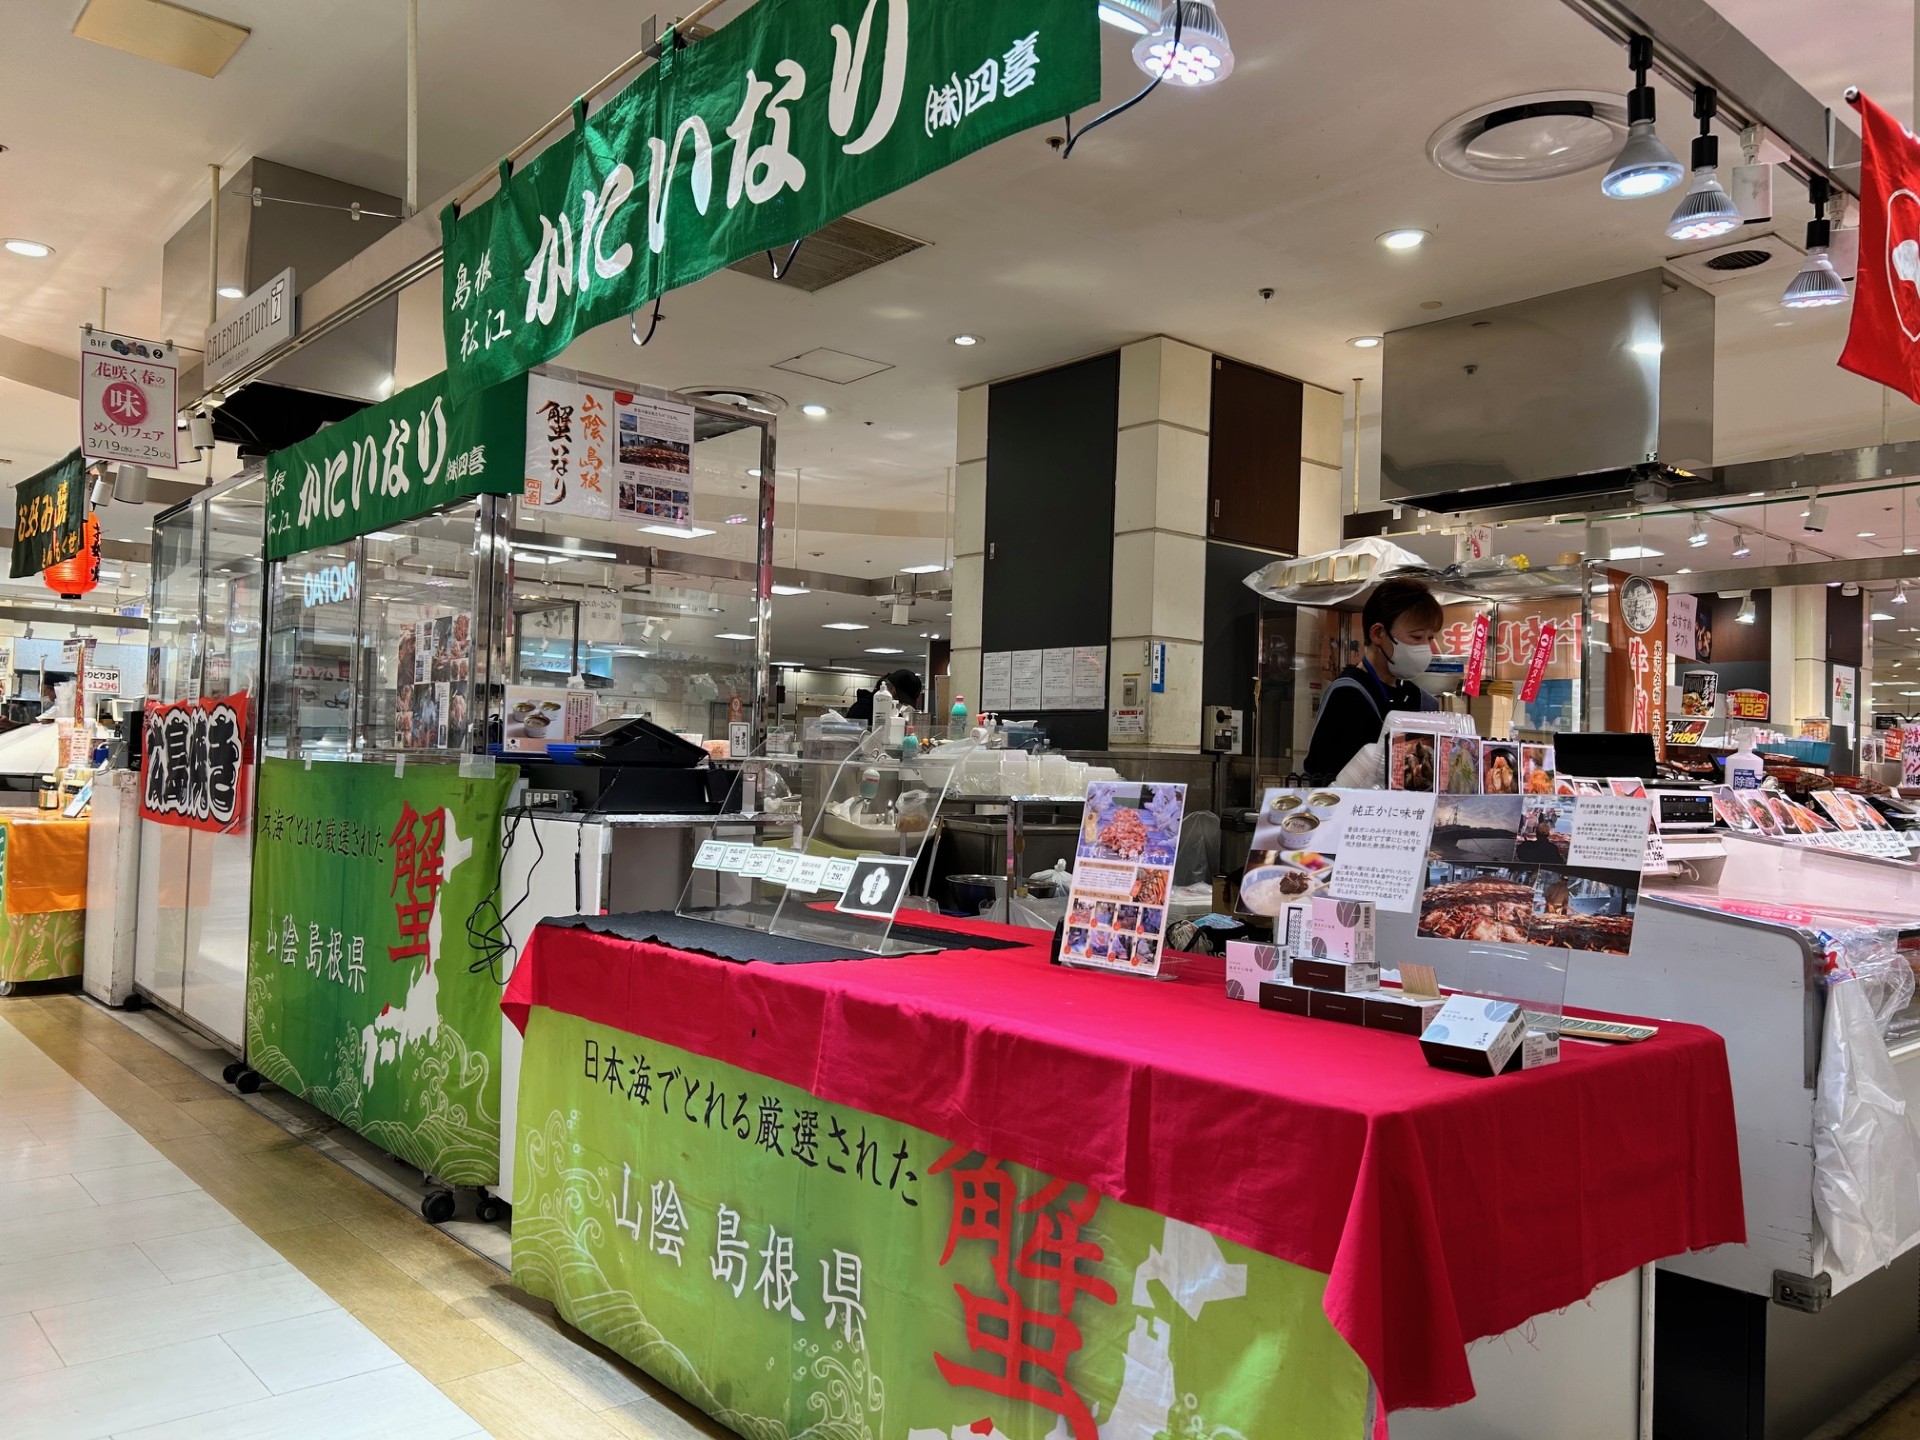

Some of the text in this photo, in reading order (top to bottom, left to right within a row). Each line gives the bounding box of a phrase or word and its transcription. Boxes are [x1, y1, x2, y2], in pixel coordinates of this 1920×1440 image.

[524, 0, 908, 326] かにいなり
[452, 246, 493, 313] 島根
[90, 338, 107, 349] B1F
[206, 297, 269, 367] CALENDARIUM
[459, 307, 512, 363] 松江
[95, 361, 166, 385] 花咲く春の
[110, 389, 142, 418] 味
[297, 395, 447, 531] かにいなり
[535, 399, 575, 506] 蟹いなり
[1351, 804, 1425, 820] 純正かに味噌
[387, 800, 447, 975] 蟹
[266, 907, 367, 995] 山陰 島根県
[584, 1038, 918, 1207] 日本海でとれる厳選された
[611, 1161, 867, 1342] 山陰 島根県
